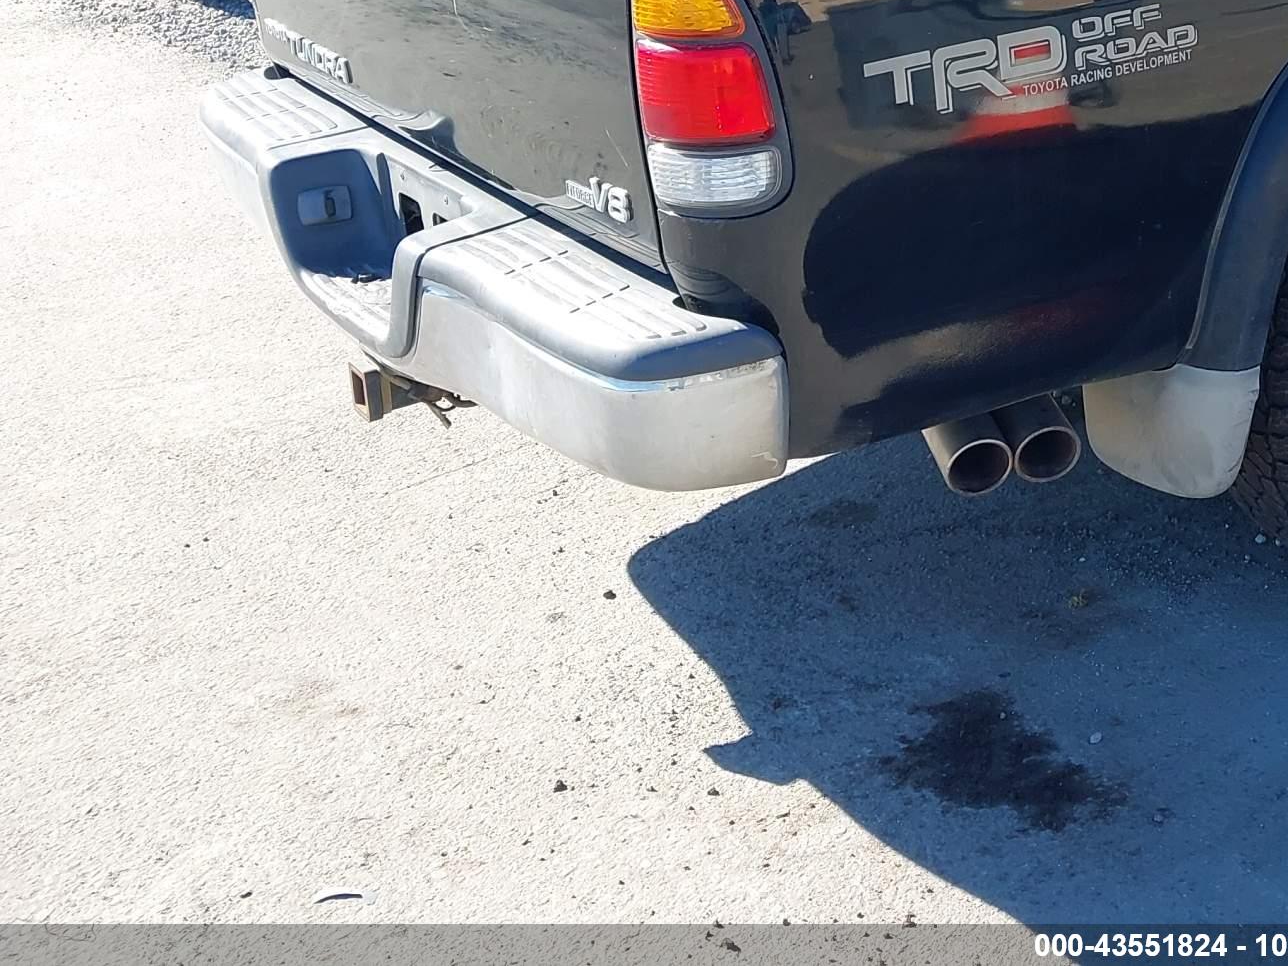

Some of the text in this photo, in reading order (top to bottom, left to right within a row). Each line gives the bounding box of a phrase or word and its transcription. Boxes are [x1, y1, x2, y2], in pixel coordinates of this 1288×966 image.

[1072, 3, 1162, 42] OFF
[286, 30, 353, 84] TUNDRA
[863, 25, 1068, 114] TRD
[1074, 24, 1199, 71] ROAD
[1022, 48, 1192, 96] TOYOTA RACING DEVELOPMENT
[589, 176, 633, 223] V8
